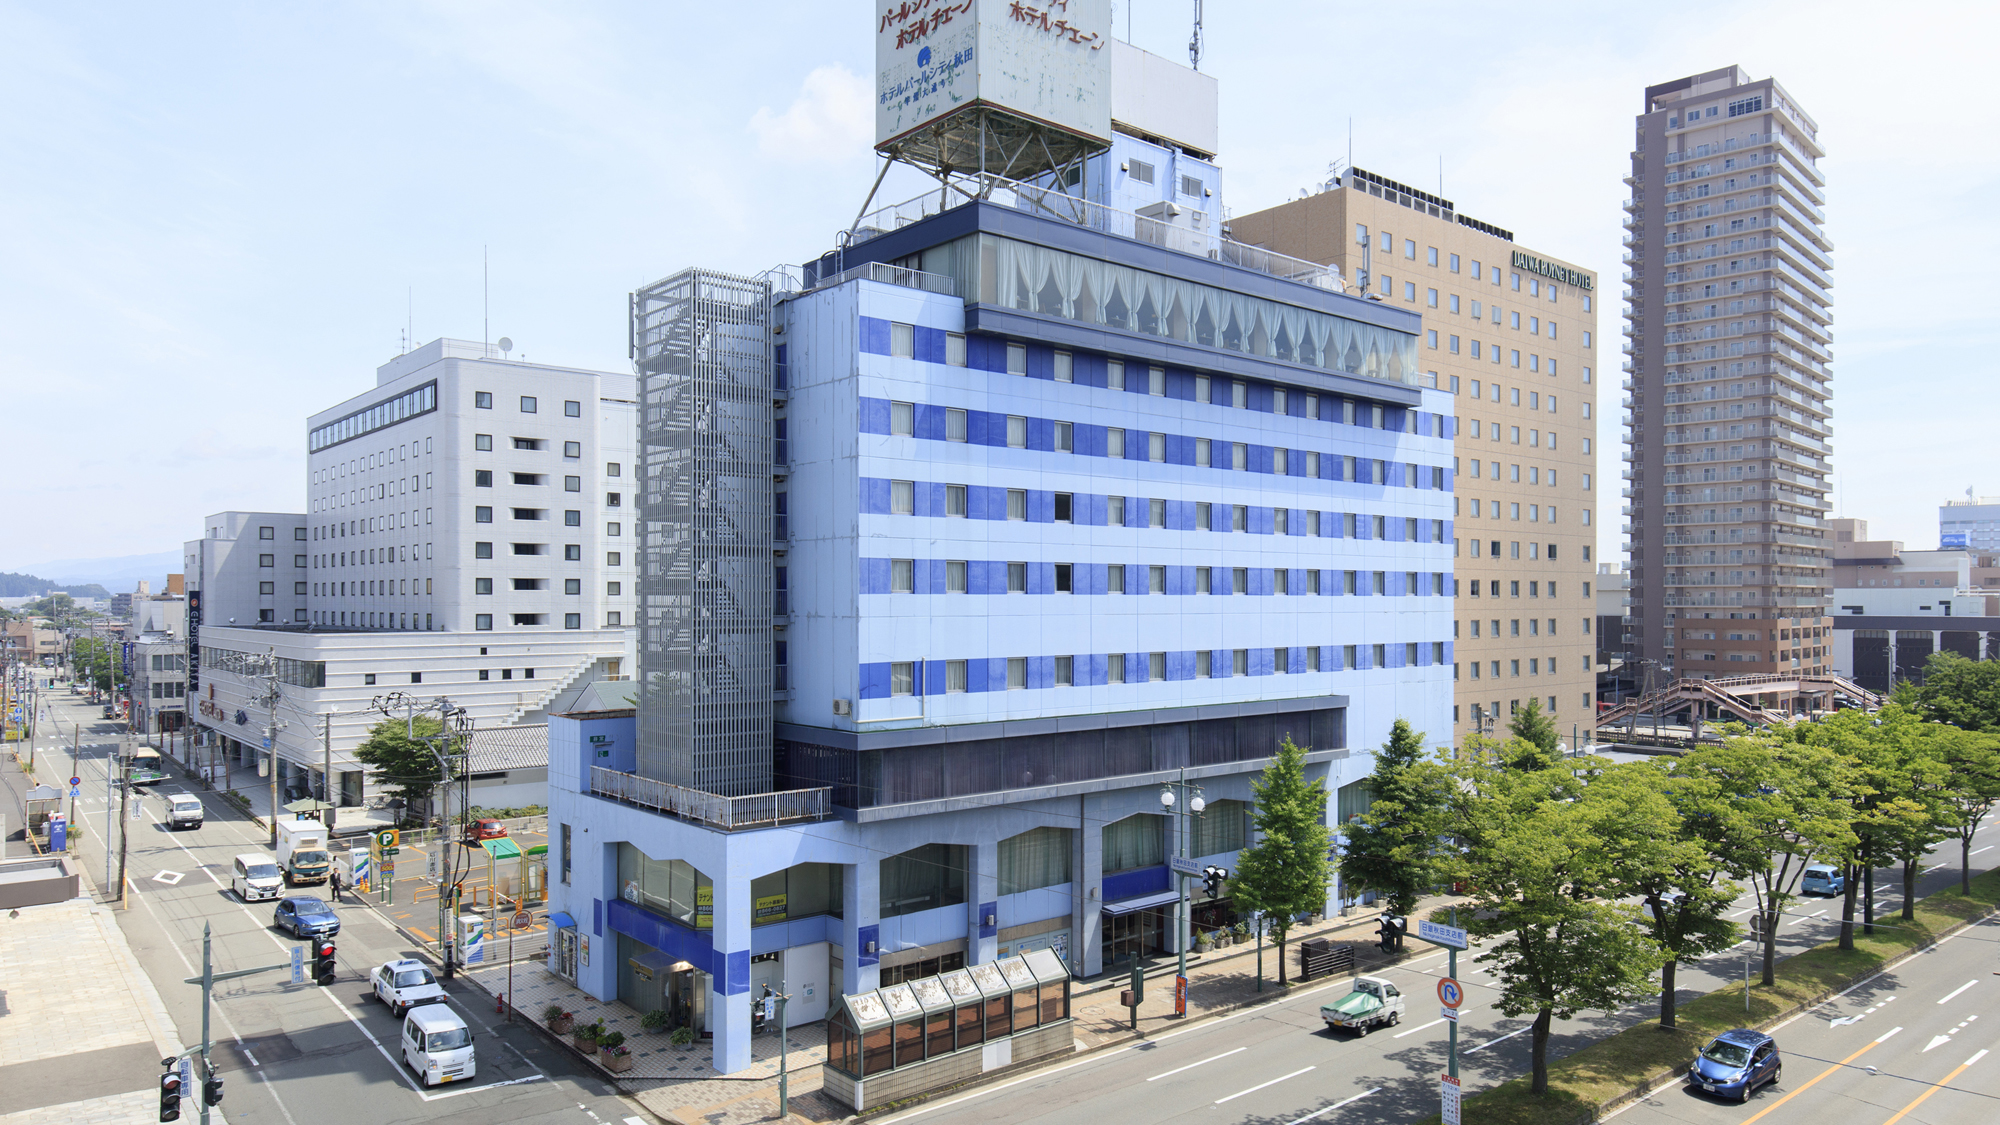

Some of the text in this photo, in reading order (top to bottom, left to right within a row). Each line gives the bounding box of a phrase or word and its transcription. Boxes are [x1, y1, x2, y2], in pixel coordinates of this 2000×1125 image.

[1009, 0, 1105, 50] ホテルチェーン
[879, 46, 974, 105] ホテルパールシティ秋田
[1512, 250, 1594, 290] DAIWA ROYNET HOTEL
[383, 834, 393, 846] P
[1422, 923, 1464, 940] 日銀秋田支店前
